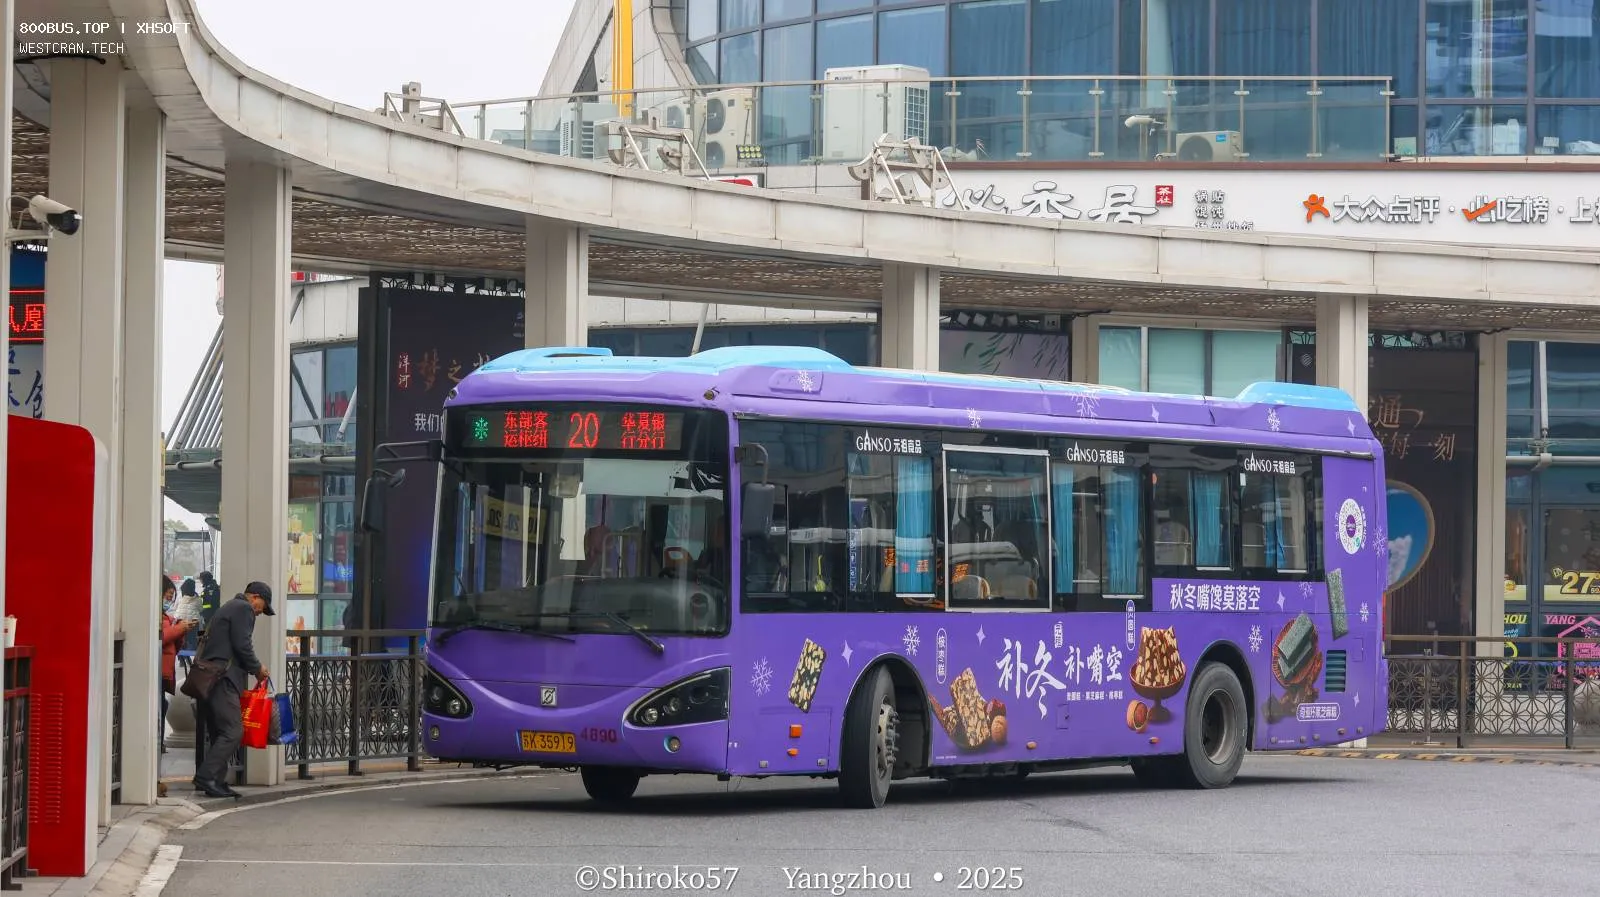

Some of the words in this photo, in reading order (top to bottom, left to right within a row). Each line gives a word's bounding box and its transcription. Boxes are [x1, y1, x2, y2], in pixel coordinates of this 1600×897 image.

[415, 412, 446, 433] 我们
[568, 412, 600, 448] 20
[856, 429, 892, 453] GANSO
[893, 438, 922, 454] 元祖食品
[1066, 440, 1099, 463] GANSO
[1100, 449, 1125, 464] 元祖食品
[1244, 451, 1272, 473] GANSO
[1273, 460, 1296, 475] 元祖食品
[1169, 584, 1261, 611] 秋冬嘴馋莫落空
[1544, 614, 1577, 625] YANG
[995, 637, 1067, 720] 补冬
[1063, 643, 1123, 685] 补嘴空
[539, 734, 574, 750] 35919
[580, 727, 617, 743] 4890
